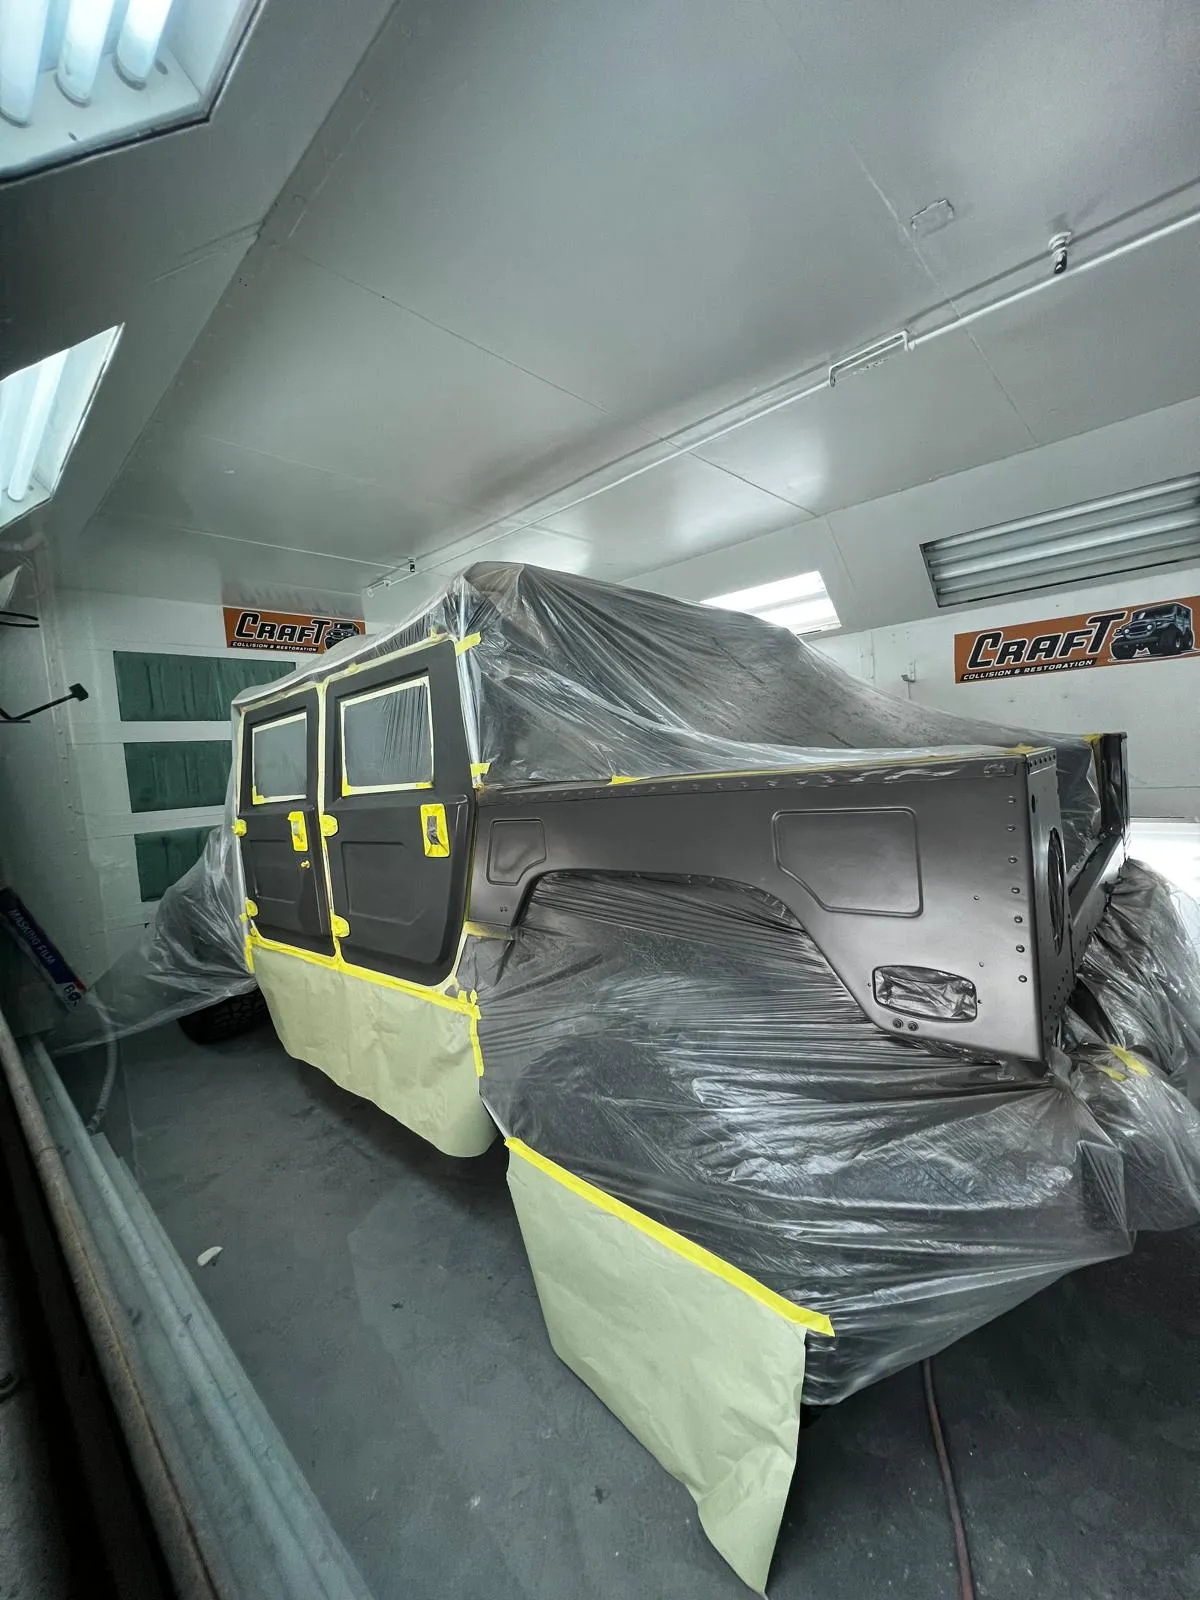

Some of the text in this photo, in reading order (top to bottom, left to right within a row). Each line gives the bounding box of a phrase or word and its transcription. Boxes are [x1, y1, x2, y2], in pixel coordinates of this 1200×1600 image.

[235, 612, 332, 645] CRAFT
[967, 611, 1128, 670] CRAFT
[232, 641, 268, 649] COLLISION
[275, 644, 317, 652] RESTORATION
[963, 659, 1093, 681] COLLISION & RESTORATION
[8, 908, 56, 965] MASKING FILM
